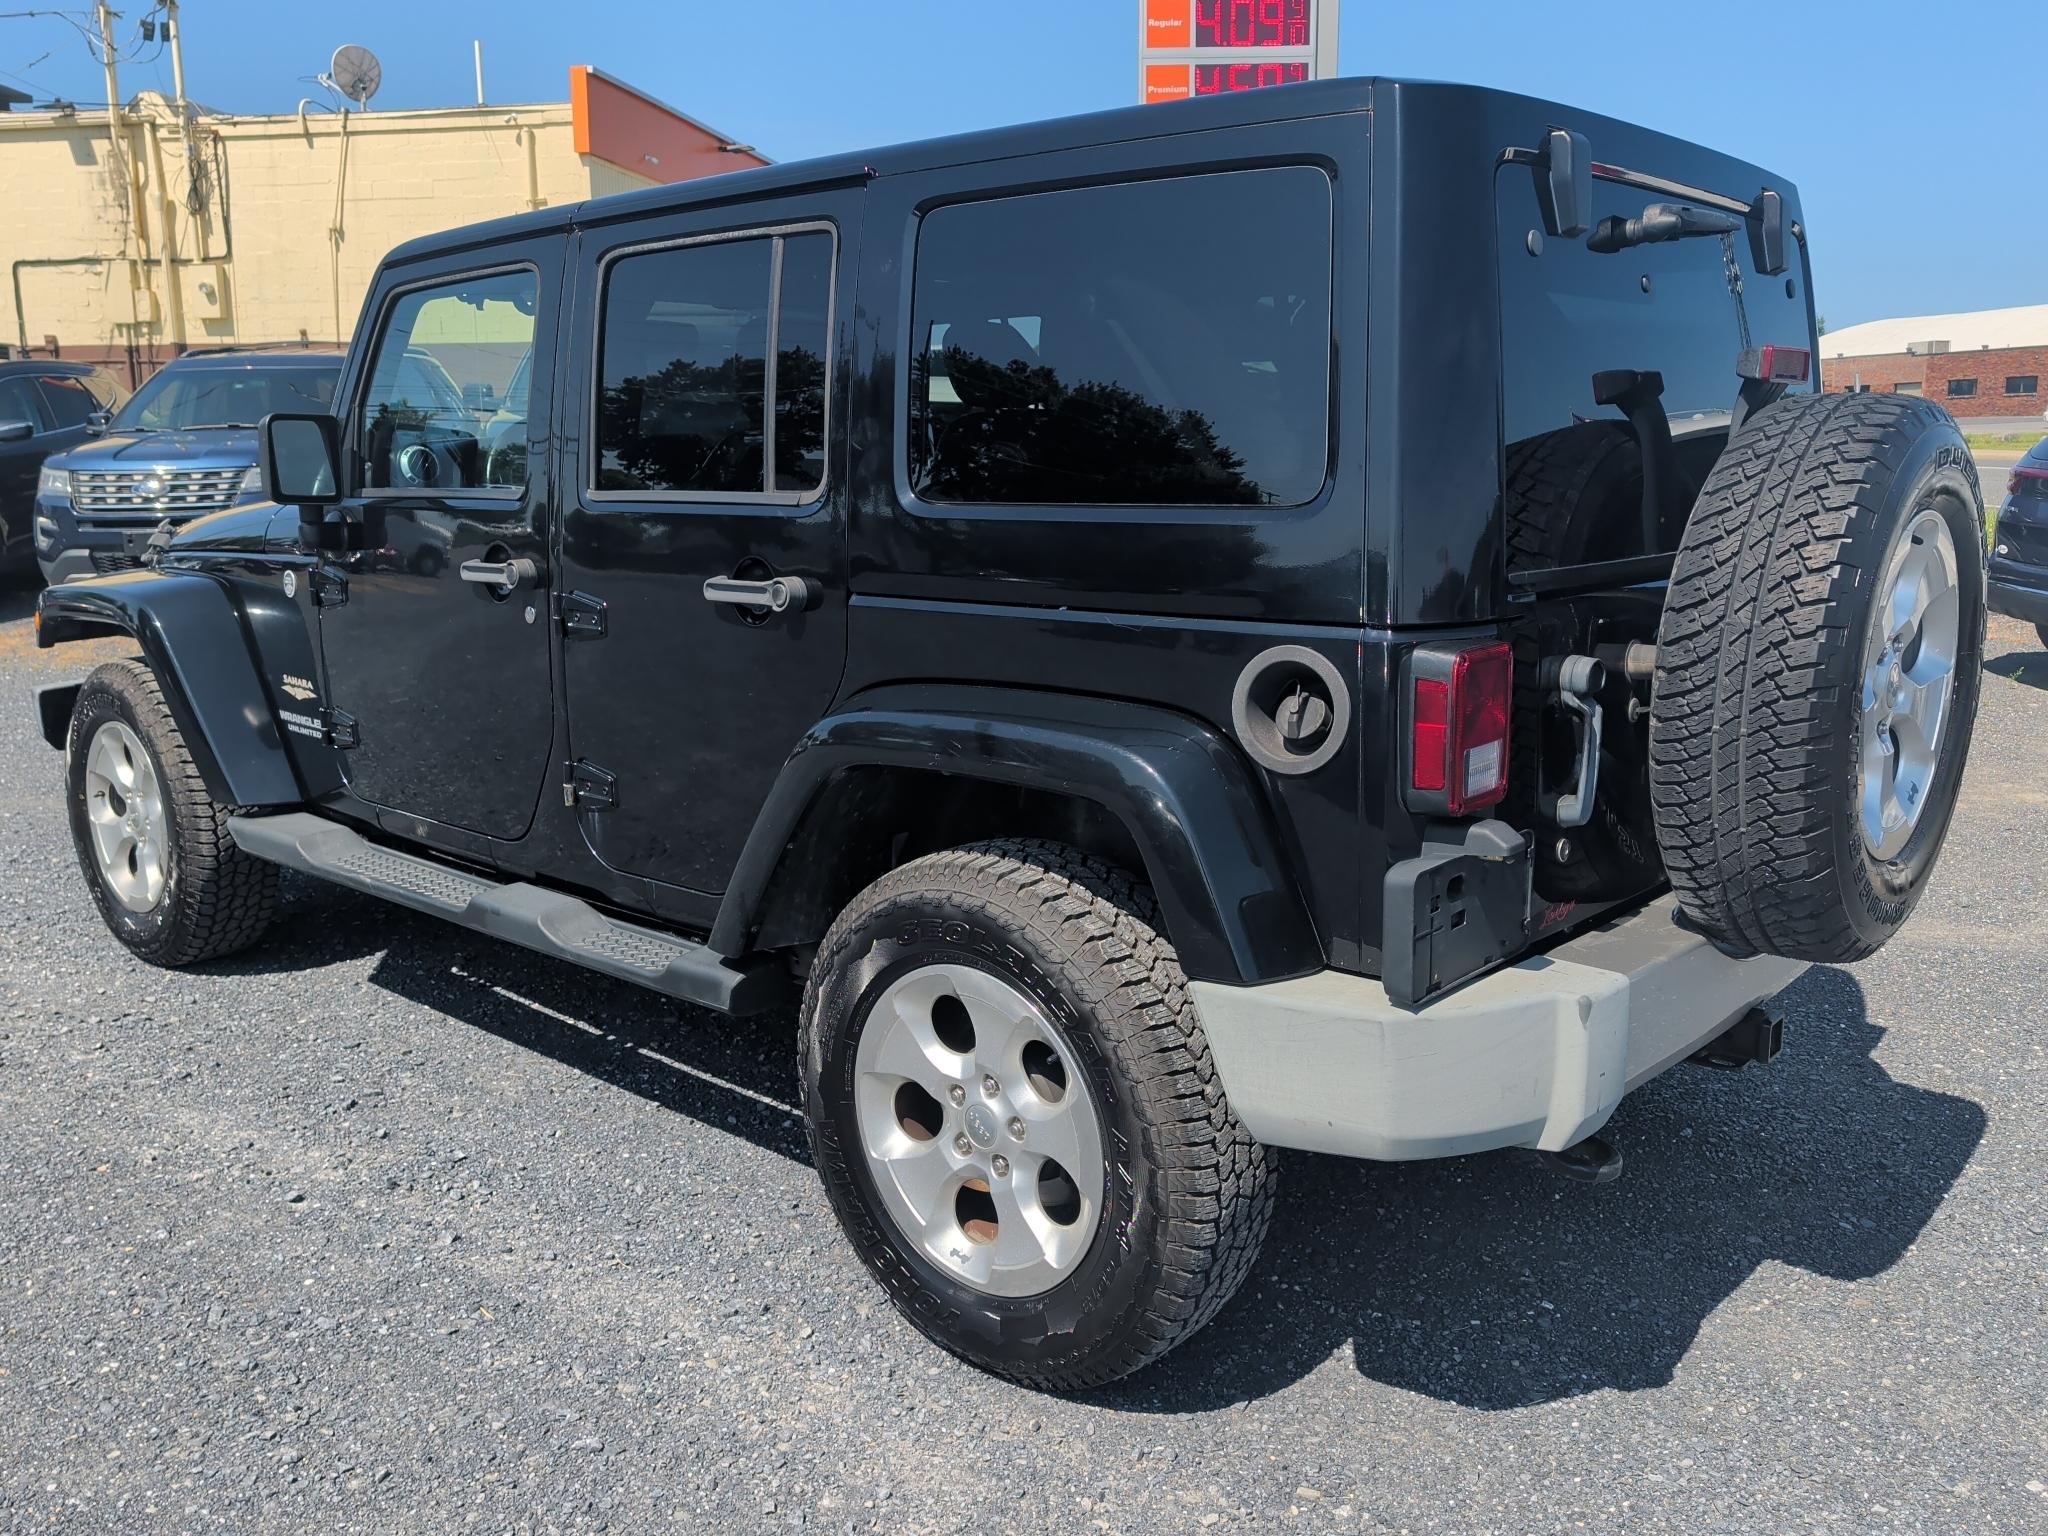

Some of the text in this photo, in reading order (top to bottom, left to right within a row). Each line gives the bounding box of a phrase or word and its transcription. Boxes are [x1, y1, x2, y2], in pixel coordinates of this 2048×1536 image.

[1148, 18, 1183, 28] Regular
[1147, 84, 1188, 94] Premium
[283, 674, 314, 690] SAHARA
[287, 724, 322, 739] UNLIMITED
